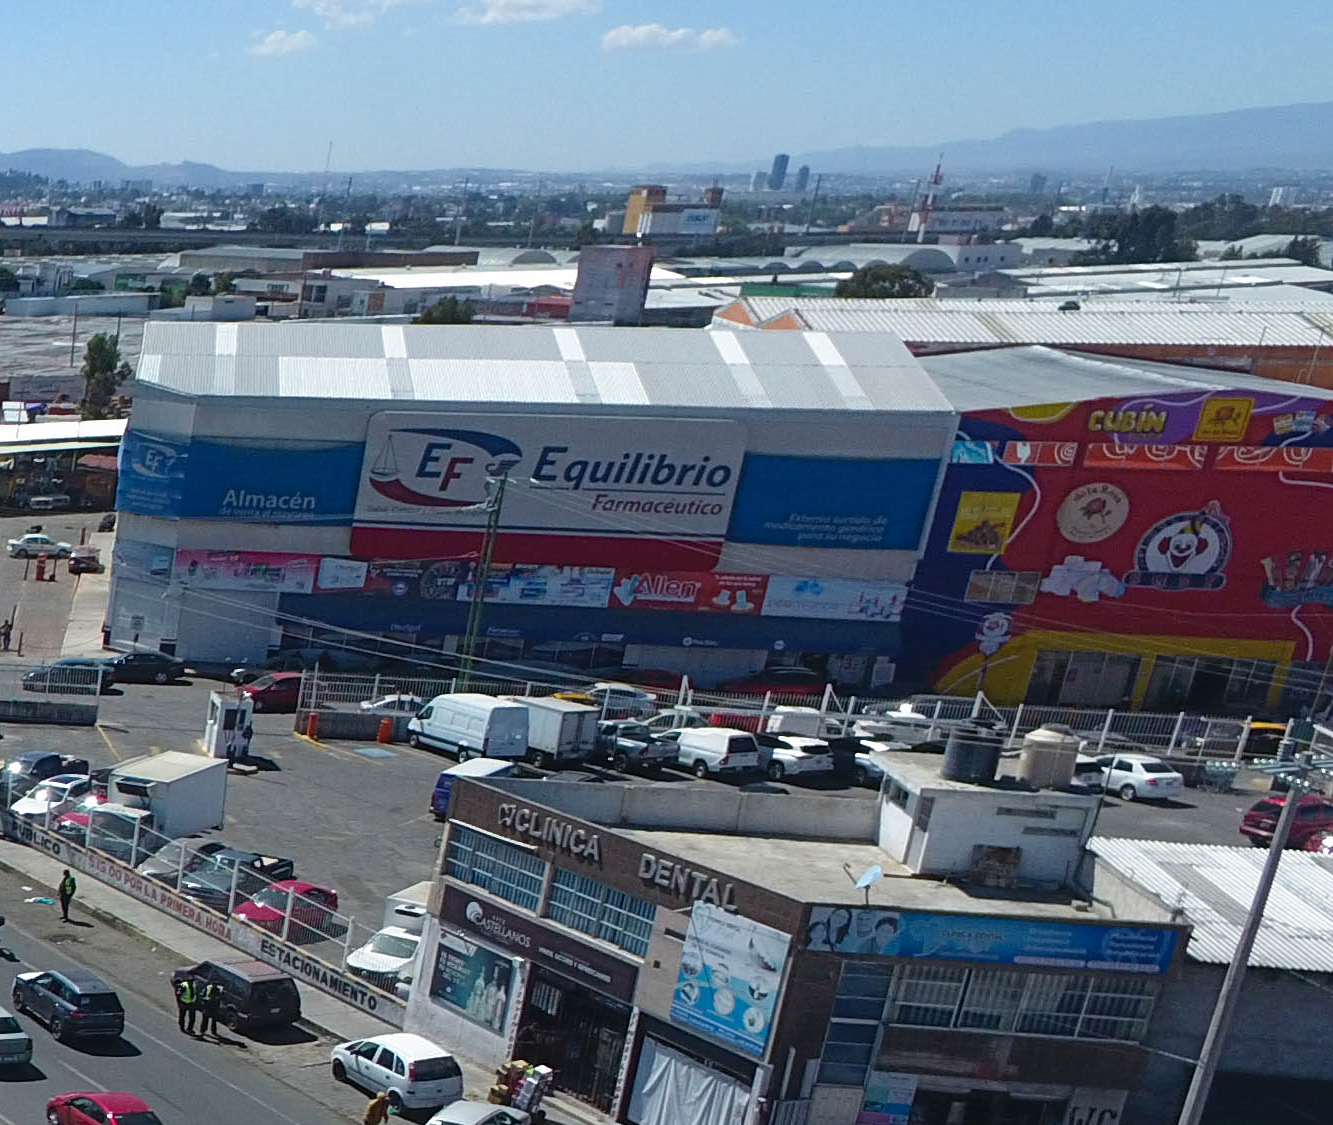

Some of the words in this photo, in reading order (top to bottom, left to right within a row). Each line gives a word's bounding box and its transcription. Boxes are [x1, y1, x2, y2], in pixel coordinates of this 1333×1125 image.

[415, 442, 474, 491] EF
[532, 445, 731, 490] Equilibrio
[222, 488, 316, 510] Almacén
[591, 494, 723, 516] Farmacéutico
[636, 572, 701, 599] Allen
[11, 819, 61, 856] PUBLICO
[514, 808, 602, 862] CLINICA
[638, 853, 738, 912] DENTAL
[123, 871, 143, 894] POR
[144, 885, 158, 902] LA
[160, 892, 204, 926] PRIMERA
[205, 914, 232, 941] HORA
[472, 912, 532, 949] CASTELLANOS
[261, 938, 378, 1011] ESTACIONAMIENTO
